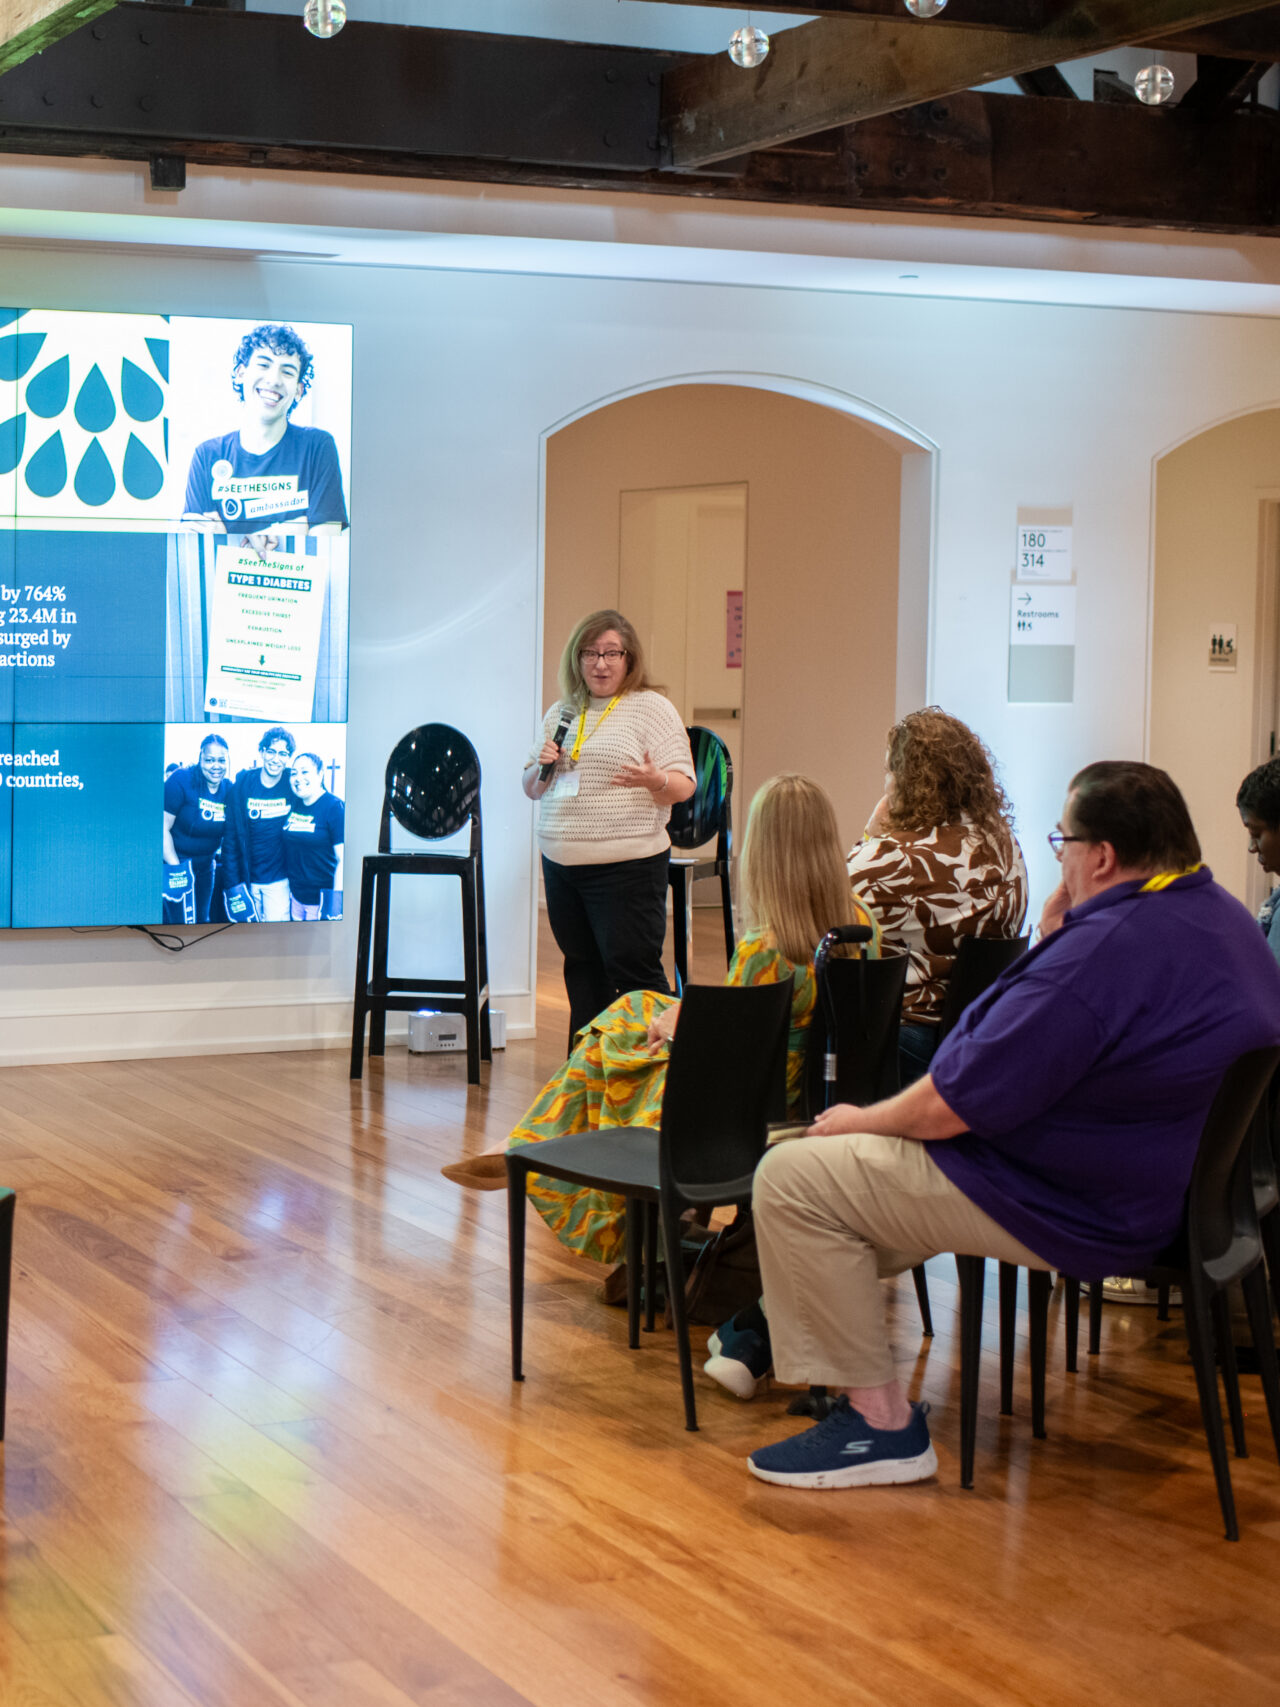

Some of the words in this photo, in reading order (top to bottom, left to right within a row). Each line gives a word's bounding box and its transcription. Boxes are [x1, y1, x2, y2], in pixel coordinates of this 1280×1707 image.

[218, 482, 292, 493] #SEETHESIGNS
[250, 498, 305, 513] ambassador
[1022, 533, 1046, 548] 180
[238, 558, 293, 571] #SeeTheSigns
[295, 564, 304, 572] of
[1022, 552, 1044, 567] 314
[230, 573, 255, 585] TYPE
[263, 577, 310, 590] DIABETES
[1, 585, 20, 604] by
[25, 586, 66, 601] 764%
[9, 608, 57, 623] 23.4M
[61, 608, 76, 623] in
[1017, 609, 1060, 618] Restrooms
[53, 630, 71, 648] by
[6, 772, 83, 789] countries,
